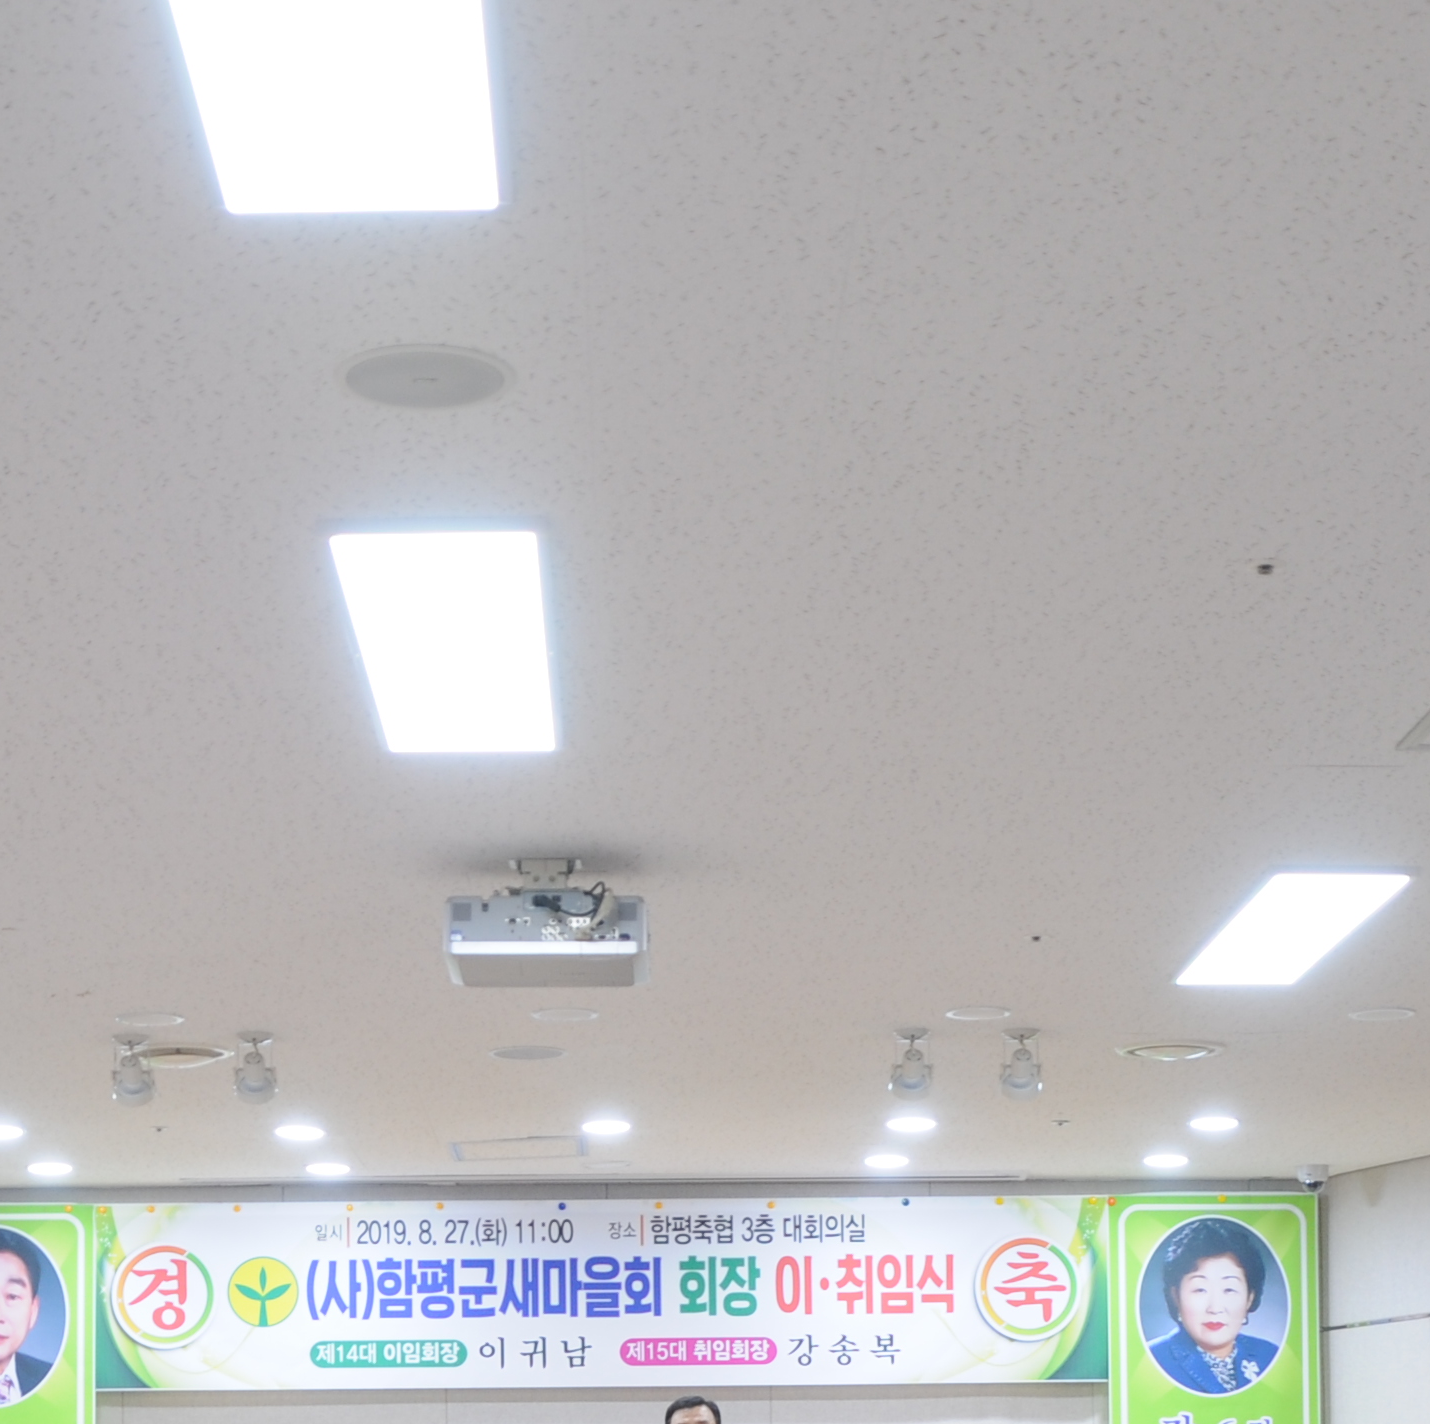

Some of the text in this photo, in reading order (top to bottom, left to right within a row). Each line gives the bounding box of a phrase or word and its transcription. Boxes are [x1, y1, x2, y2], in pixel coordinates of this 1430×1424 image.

[314, 1212, 867, 1247] 일시 2019. 8. 27.(화) 11:00 장소 함평축협 3층 대회의실
[128, 1257, 191, 1331] 경
[306, 1253, 955, 1321] (사)함평군새마을회 회장 이·취임식
[993, 1250, 1068, 1323] 축
[315, 1342, 377, 1364] 제14대
[382, 1341, 460, 1364] 이임회장
[625, 1340, 688, 1362] 제15대
[692, 1339, 771, 1361] 취임회장
